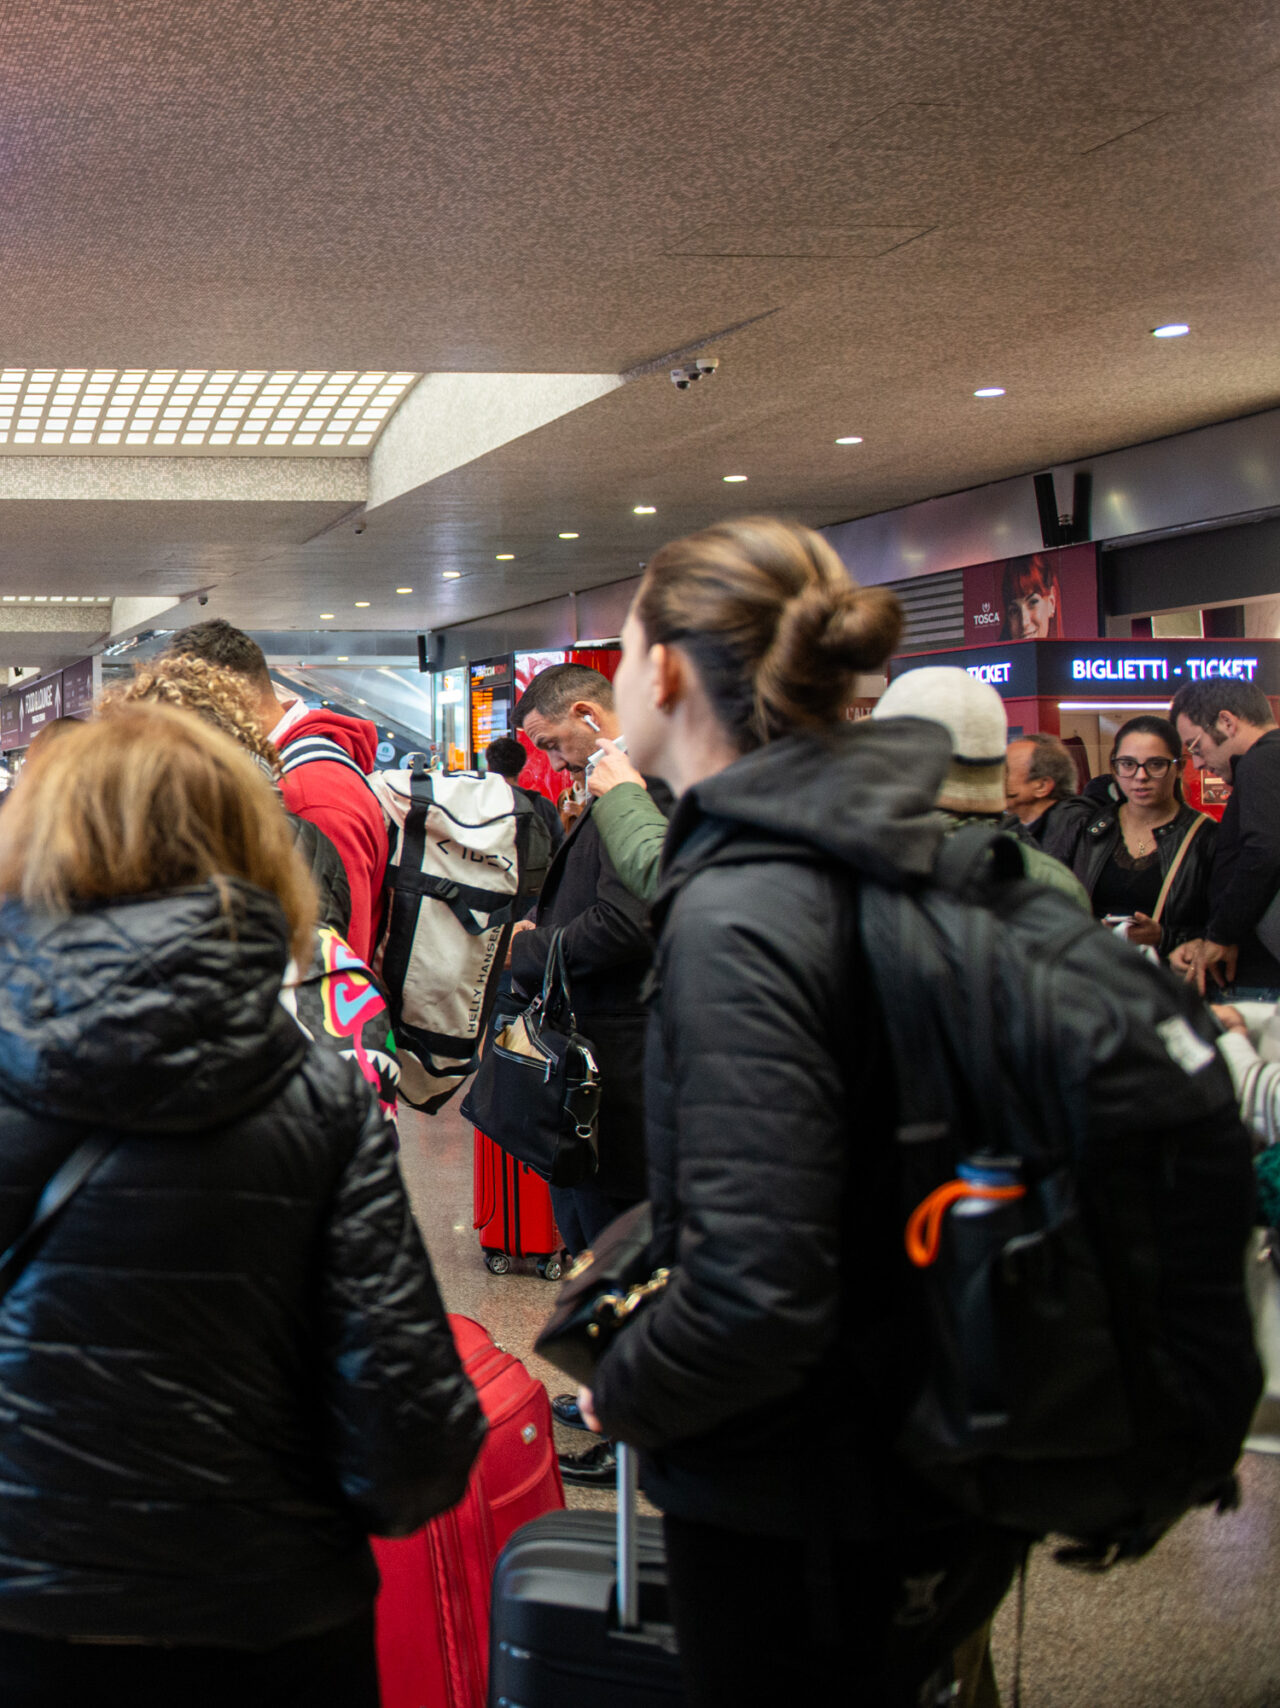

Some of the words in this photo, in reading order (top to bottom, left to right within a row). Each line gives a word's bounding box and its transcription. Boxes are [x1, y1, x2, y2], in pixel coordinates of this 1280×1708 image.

[973, 611, 1000, 626] TOSCA
[966, 662, 1012, 684] TICKET
[1071, 658, 1169, 681] BIGLIETTI
[1185, 657, 1259, 682] TICKET
[466, 988, 483, 1033] HELLY
[476, 925, 502, 984] HANSEN
